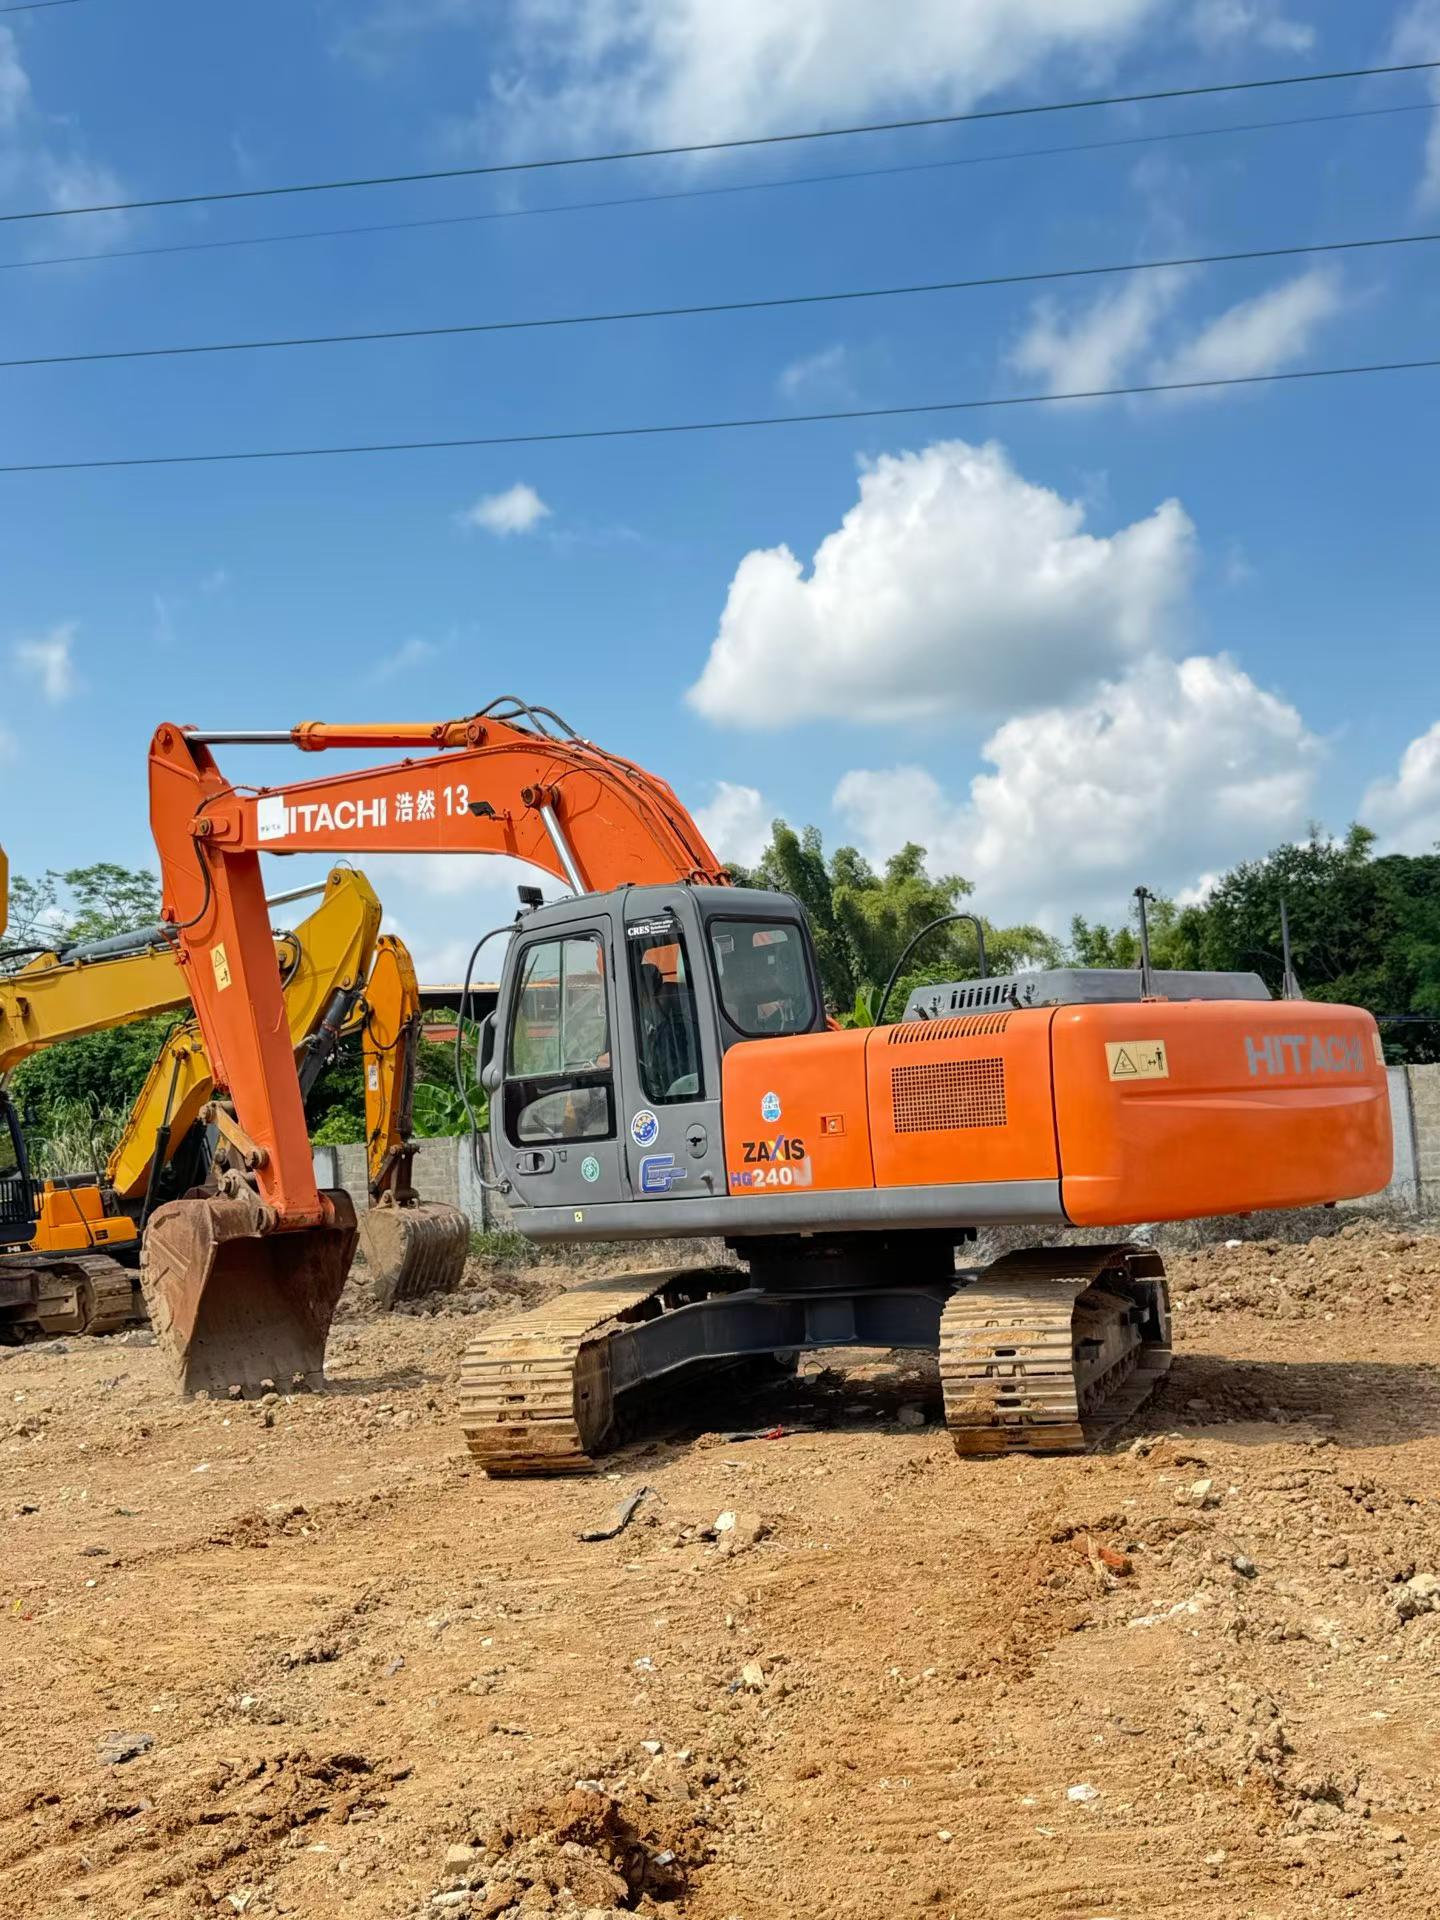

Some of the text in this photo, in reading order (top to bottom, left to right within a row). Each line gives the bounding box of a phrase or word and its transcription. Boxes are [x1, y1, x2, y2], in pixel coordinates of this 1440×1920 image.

[395, 784, 469, 823] 浩然 13
[627, 925, 650, 936] CRES
[1244, 1034, 1365, 1076] HITACHI
[742, 1134, 805, 1163] ZAXIS
